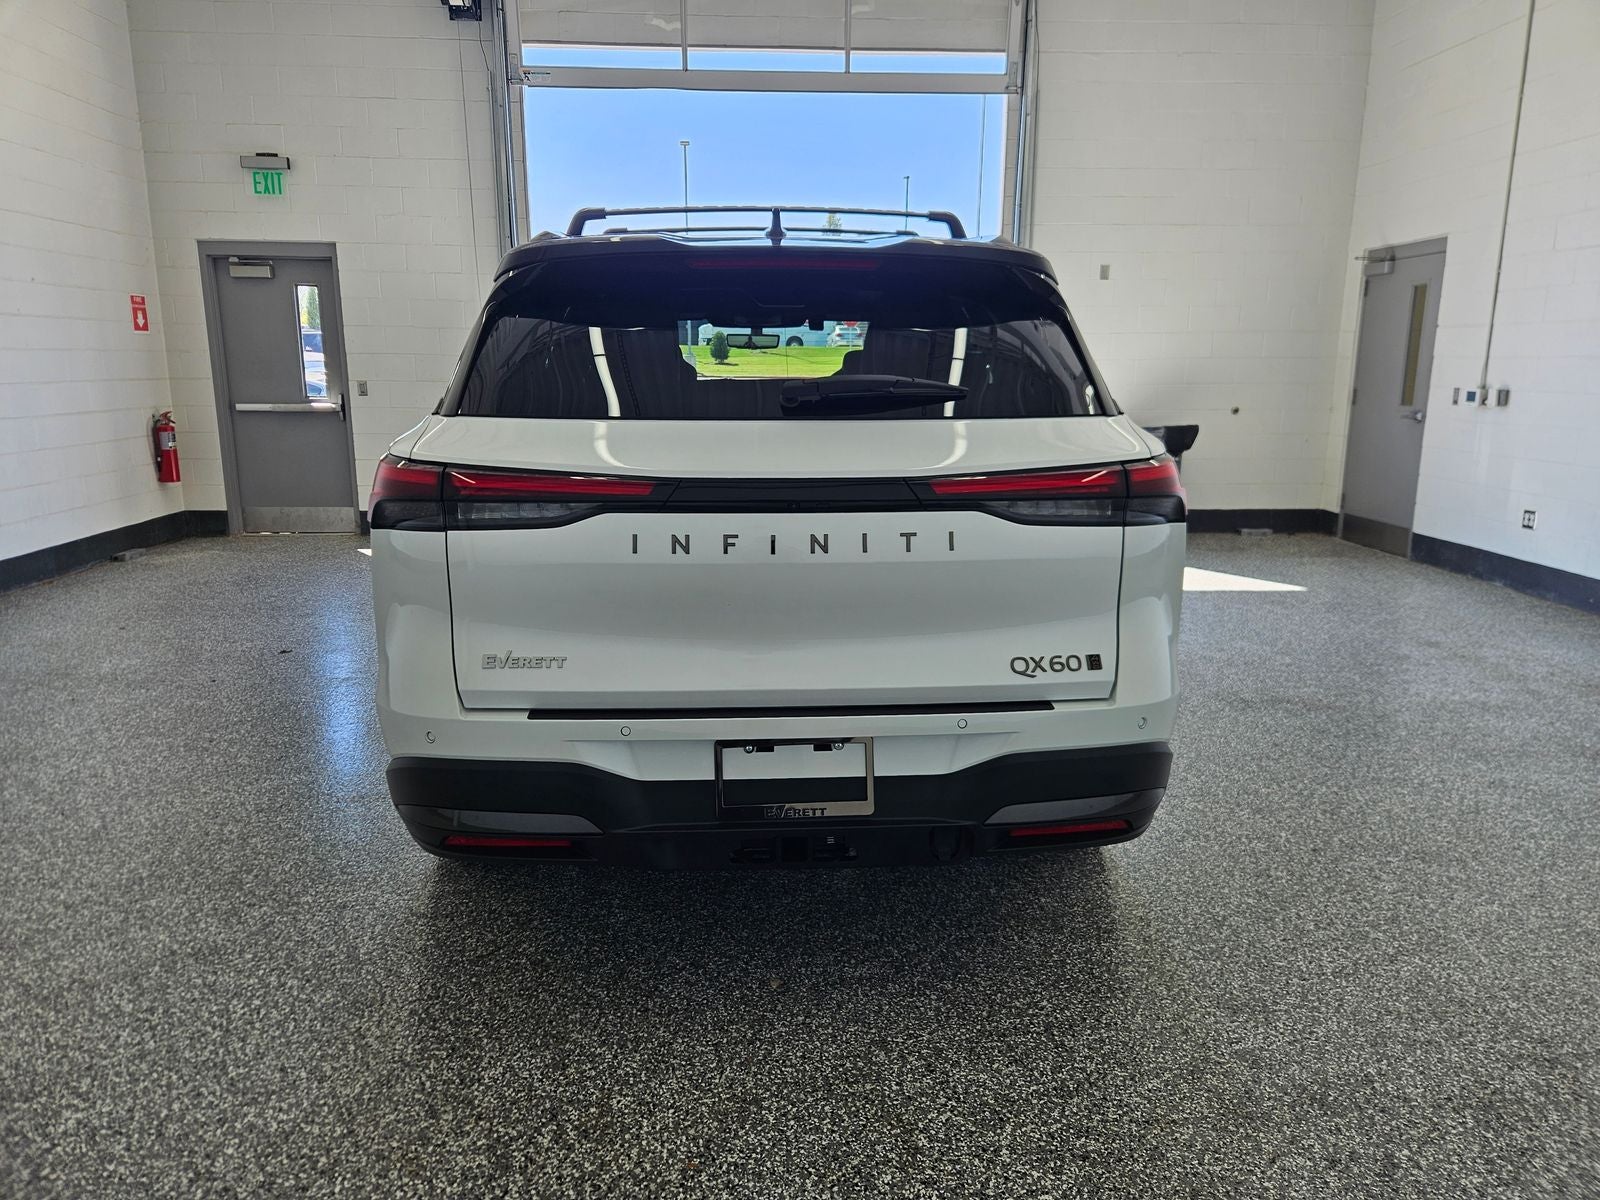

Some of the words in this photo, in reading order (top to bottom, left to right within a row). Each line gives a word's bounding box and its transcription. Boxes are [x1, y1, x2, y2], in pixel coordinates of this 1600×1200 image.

[252, 171, 283, 195] EXIT
[632, 531, 955, 555] INFINITI
[481, 650, 567, 669] EVERETT
[1010, 655, 1082, 678] QX60
[764, 804, 827, 818] EVERETT
